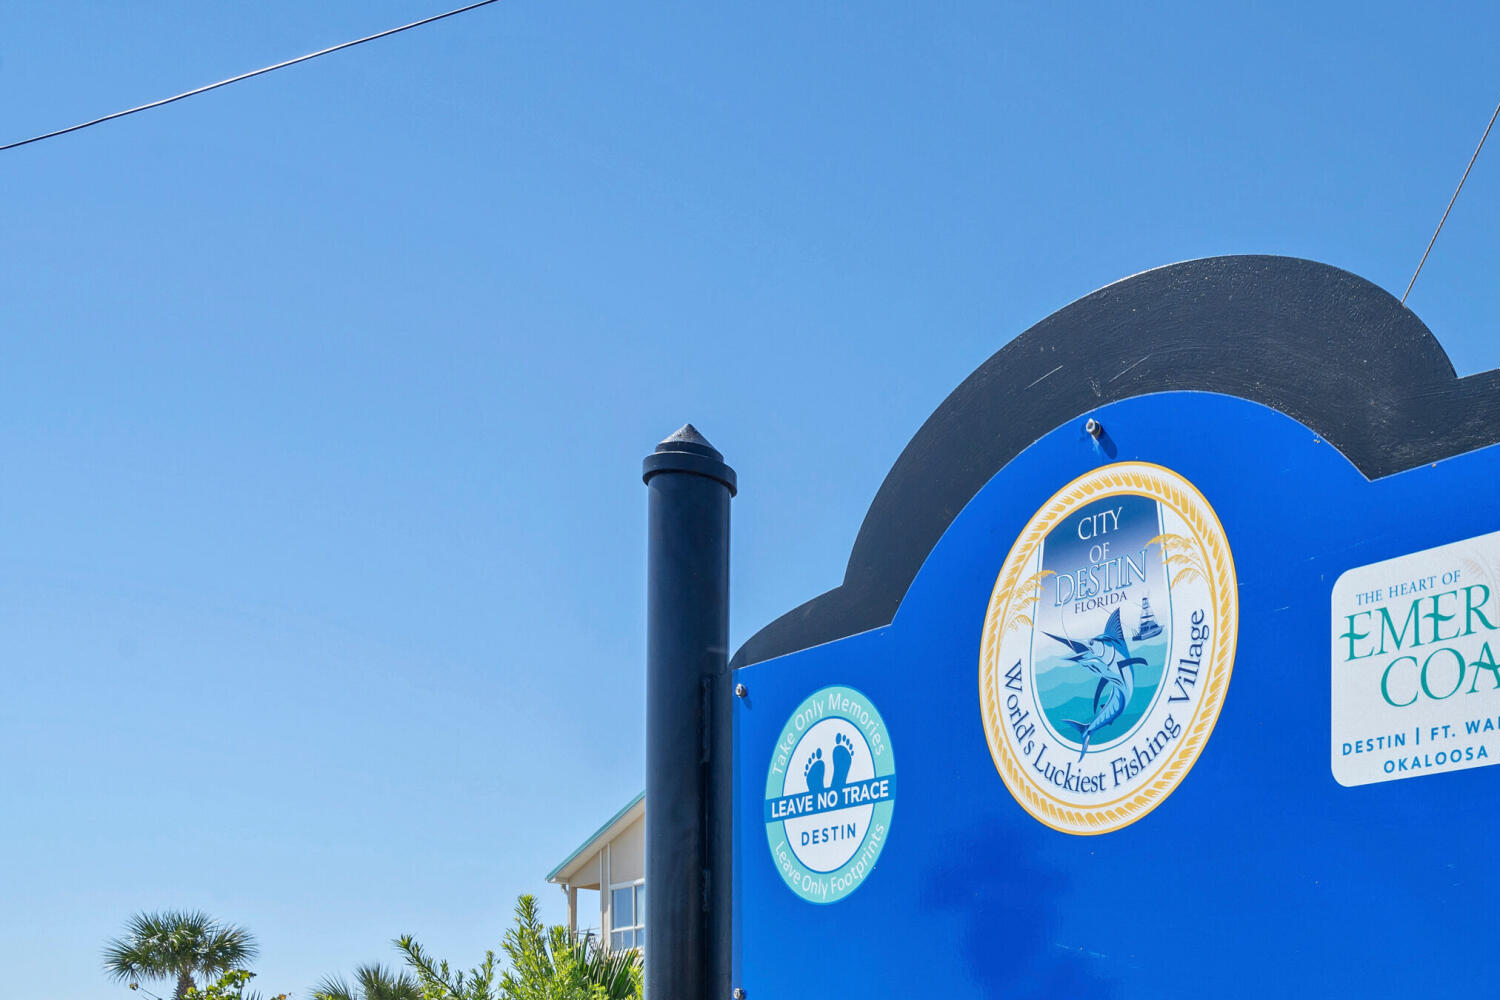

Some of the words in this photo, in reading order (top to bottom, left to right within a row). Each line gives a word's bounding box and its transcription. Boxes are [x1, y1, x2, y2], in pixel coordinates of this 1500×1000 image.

[1077, 507, 1123, 541] CITY
[1089, 543, 1111, 563] OF
[1054, 549, 1148, 607] DESTIN
[1355, 588, 1383, 607] THE
[1389, 575, 1438, 598] HEART
[1442, 569, 1462, 585] OF
[1074, 591, 1127, 614] FLORIDA
[1004, 658, 1035, 755] World's
[1032, 745, 1107, 793] Luckiest
[1111, 713, 1182, 788] Fishing
[1168, 608, 1210, 706] Village
[772, 732, 796, 776] Take
[795, 699, 824, 731] Only
[828, 693, 885, 756] Memories
[1342, 731, 1406, 757] DESTIN
[1430, 723, 1456, 742] FT.
[1383, 745, 1489, 774] OKALOOSA
[771, 794, 814, 819] LEAVE
[817, 790, 838, 810] NO
[842, 780, 889, 804] TRACE
[801, 822, 856, 846] DESTIN
[775, 840, 801, 885] Leave
[801, 875, 828, 899] Only
[831, 823, 885, 893] Footprints
